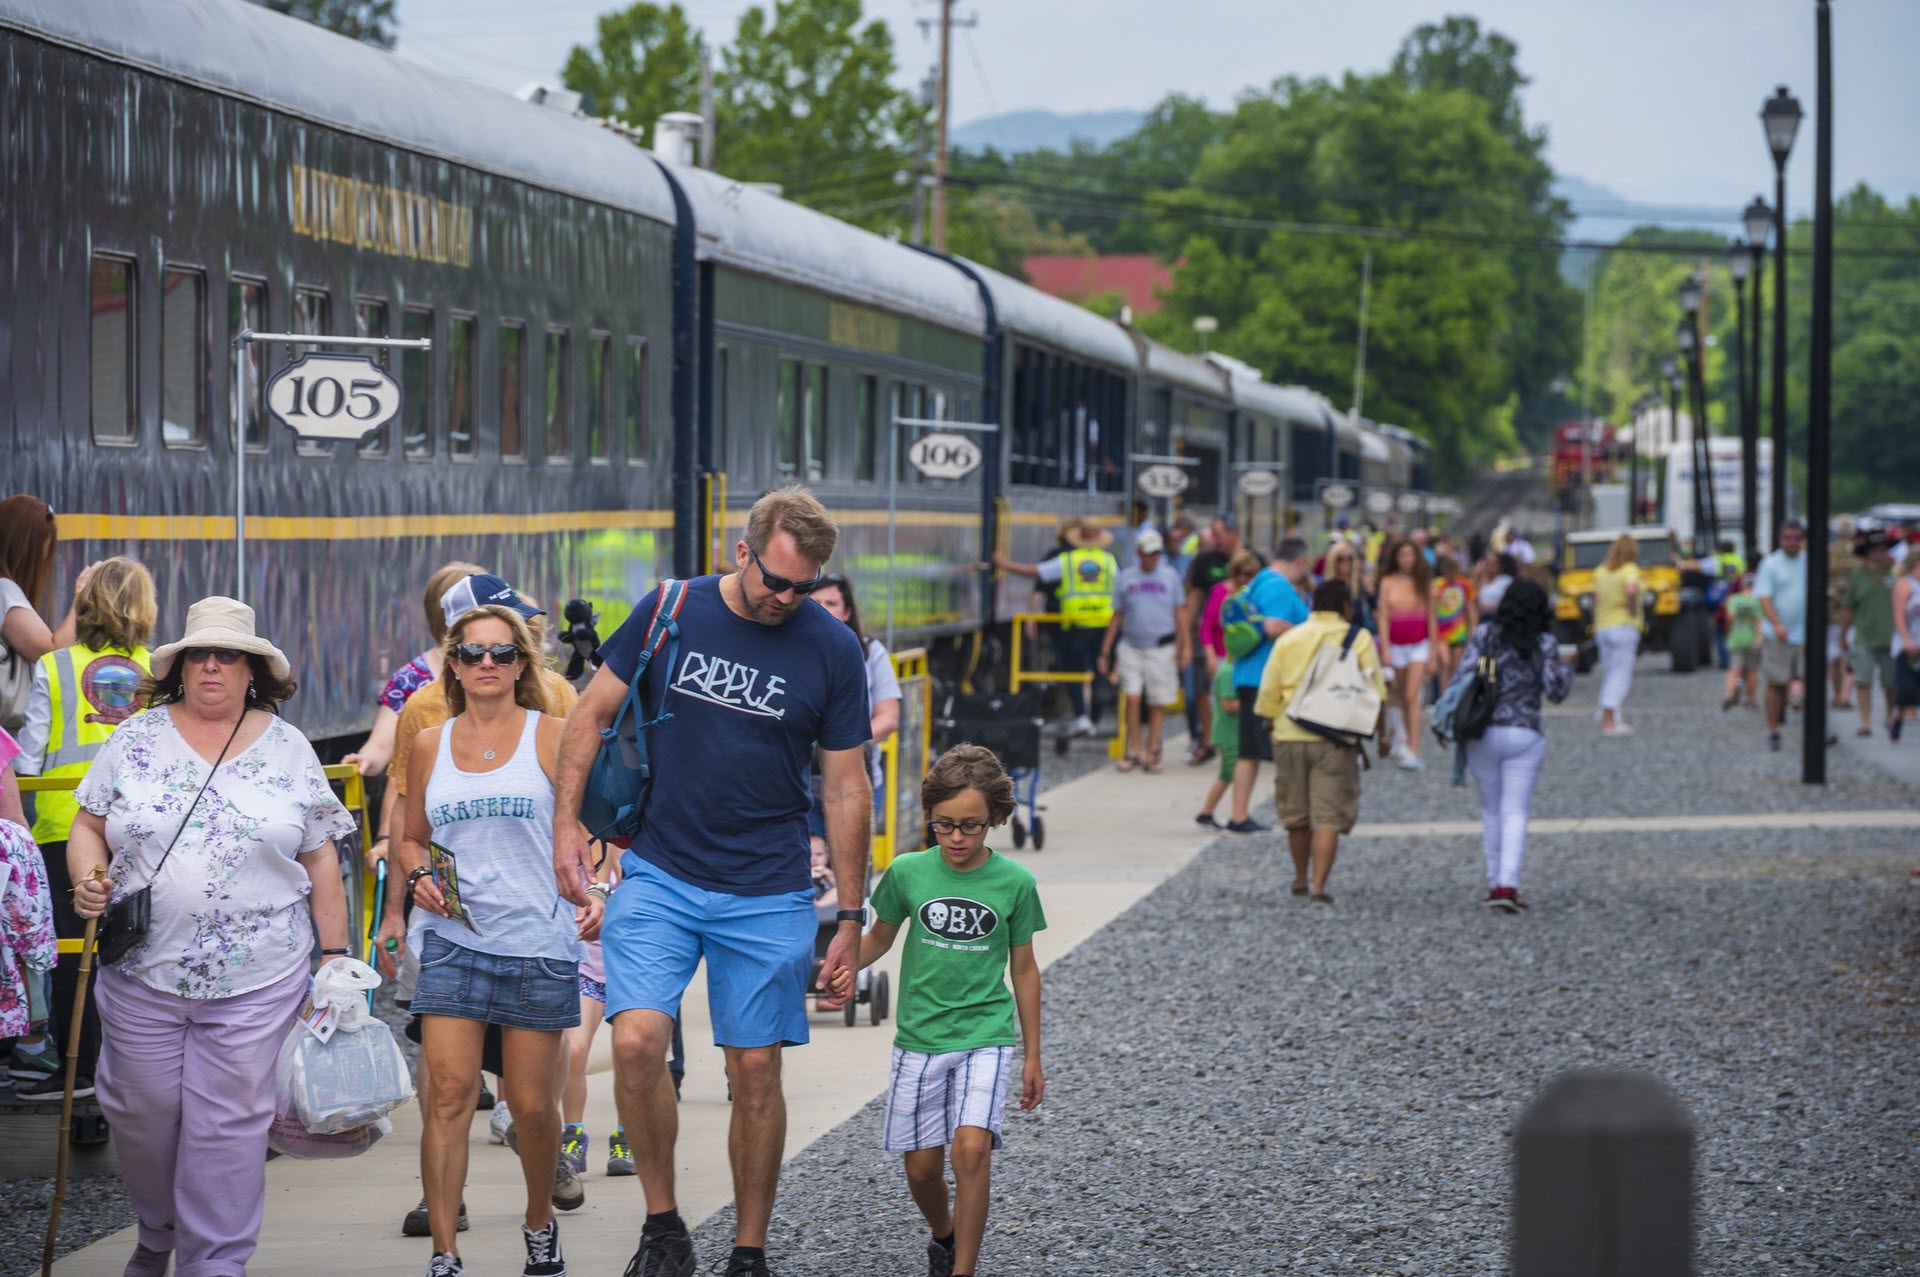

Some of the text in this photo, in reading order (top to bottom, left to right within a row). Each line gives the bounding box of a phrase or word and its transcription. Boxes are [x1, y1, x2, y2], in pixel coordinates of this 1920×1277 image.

[286, 376, 383, 420] 105
[921, 443, 972, 469] 106
[677, 651, 787, 717] RIPPLE
[430, 796, 536, 829] GRATEFUL
